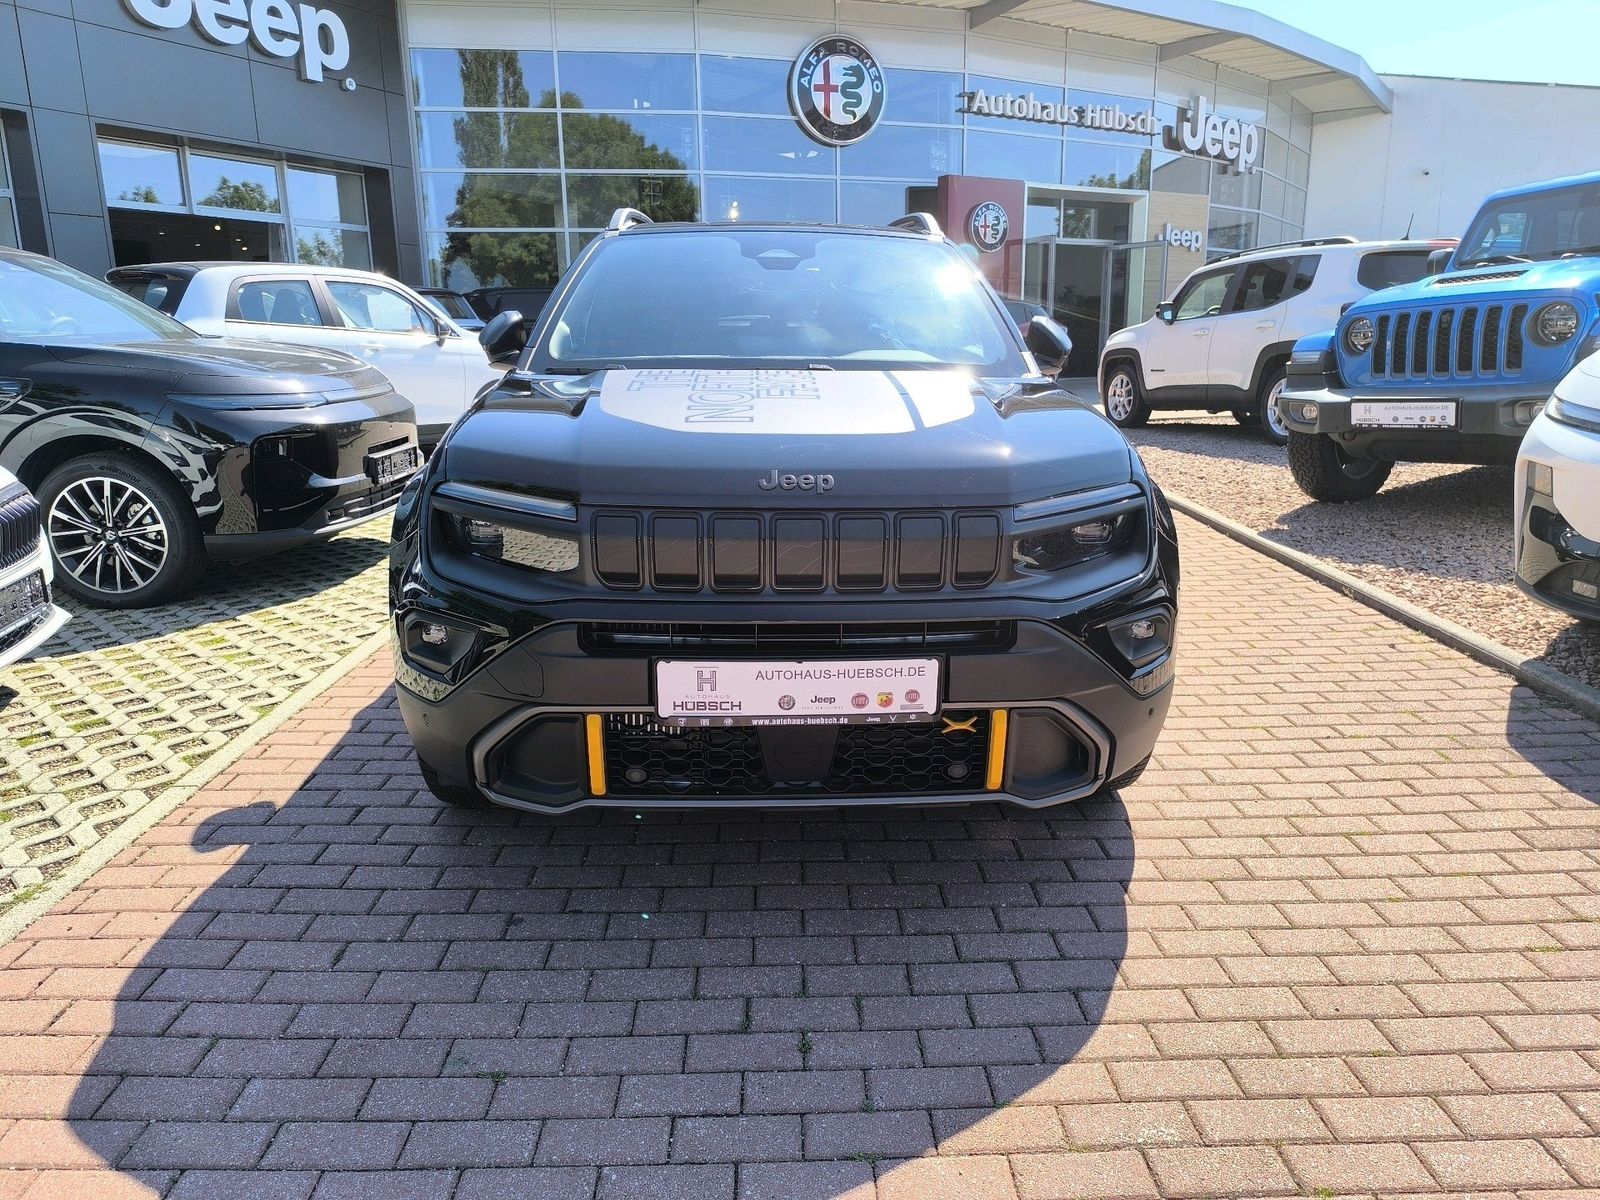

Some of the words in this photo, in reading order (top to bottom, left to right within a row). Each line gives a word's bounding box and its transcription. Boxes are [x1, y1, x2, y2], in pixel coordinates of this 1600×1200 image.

[800, 46, 830, 89] ALFA
[835, 41, 882, 94] ROMEO
[972, 88, 1079, 124] Autohaus
[1085, 103, 1158, 135] Hübsch
[1183, 95, 1259, 173] Jeep
[757, 469, 835, 495] Jeep
[755, 666, 926, 681] AUTOHAUS-HUEBSCH.DE
[673, 701, 742, 711] HÜBSCH
[810, 695, 836, 705] Jeep
[752, 716, 848, 726] www.autohaus-huebsch.de
